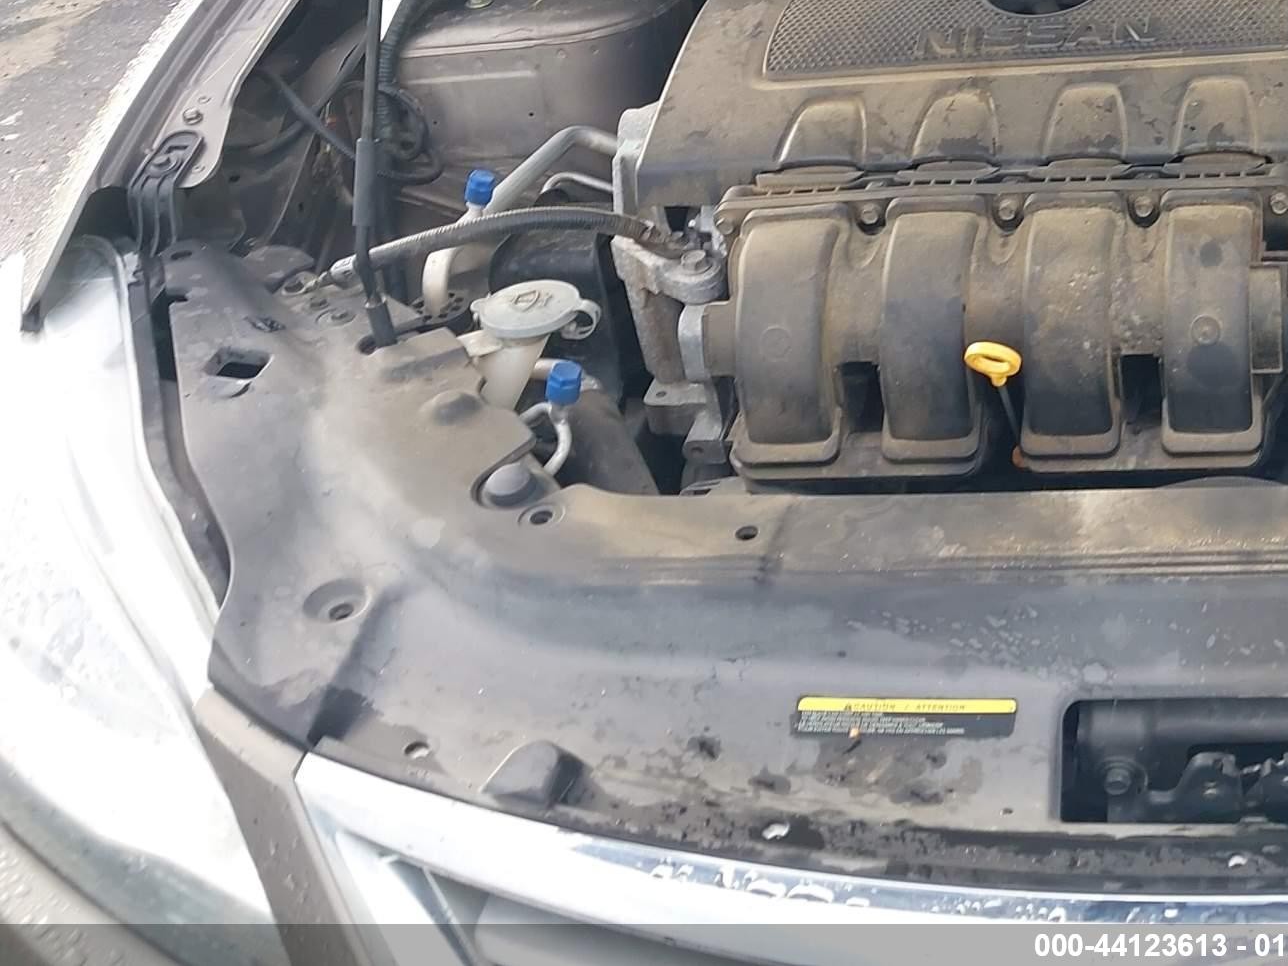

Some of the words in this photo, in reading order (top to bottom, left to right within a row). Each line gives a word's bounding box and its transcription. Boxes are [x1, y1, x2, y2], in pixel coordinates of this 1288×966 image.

[917, 14, 1156, 57] NISSAN
[853, 702, 896, 712] CAUTION
[914, 703, 967, 712] ATTENTION
